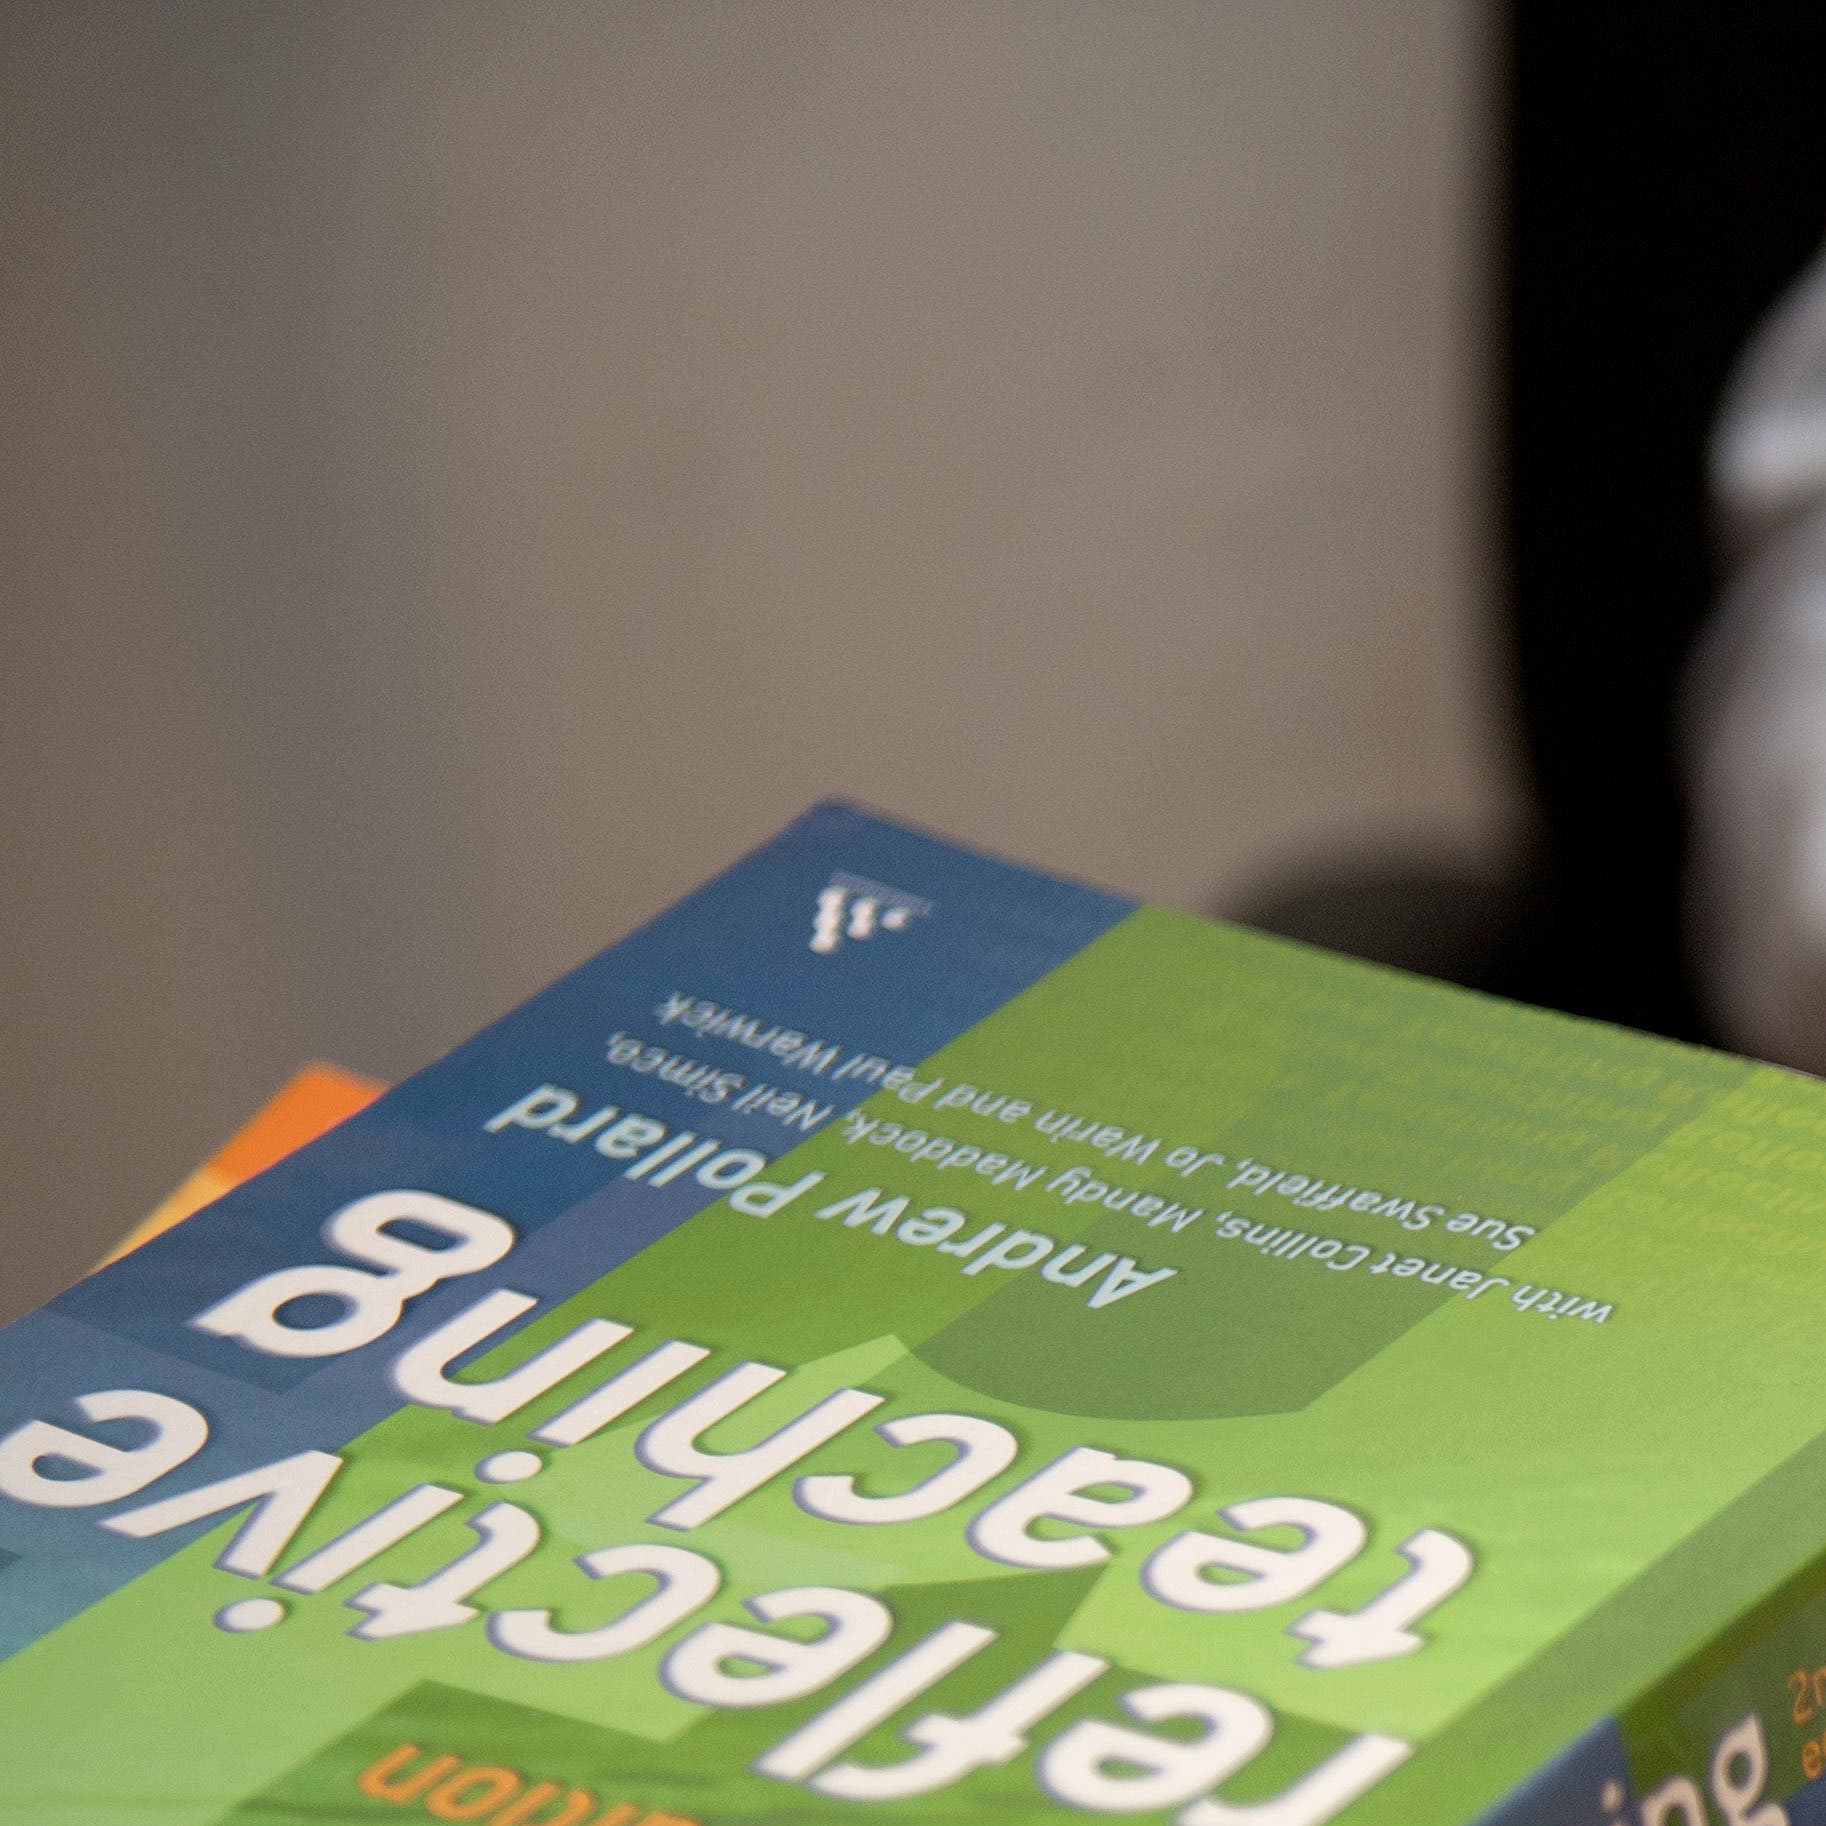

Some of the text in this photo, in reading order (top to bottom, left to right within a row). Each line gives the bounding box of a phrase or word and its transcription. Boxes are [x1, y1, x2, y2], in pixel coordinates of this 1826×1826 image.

[654, 991, 1537, 1254] Sue Swaffield, Jo Warin and Paul Warwick
[730, 1085, 836, 1132] Neil
[843, 1107, 1050, 1193] Maddock,
[482, 1081, 1179, 1310] Andrew Pollard
[1044, 1165, 1201, 1234] Mandy
[1213, 1208, 1371, 1272] Collins,
[1370, 1249, 1510, 1302] Janet
[1510, 1283, 1616, 1326] with
[185, 1186, 1477, 1672] teaching
